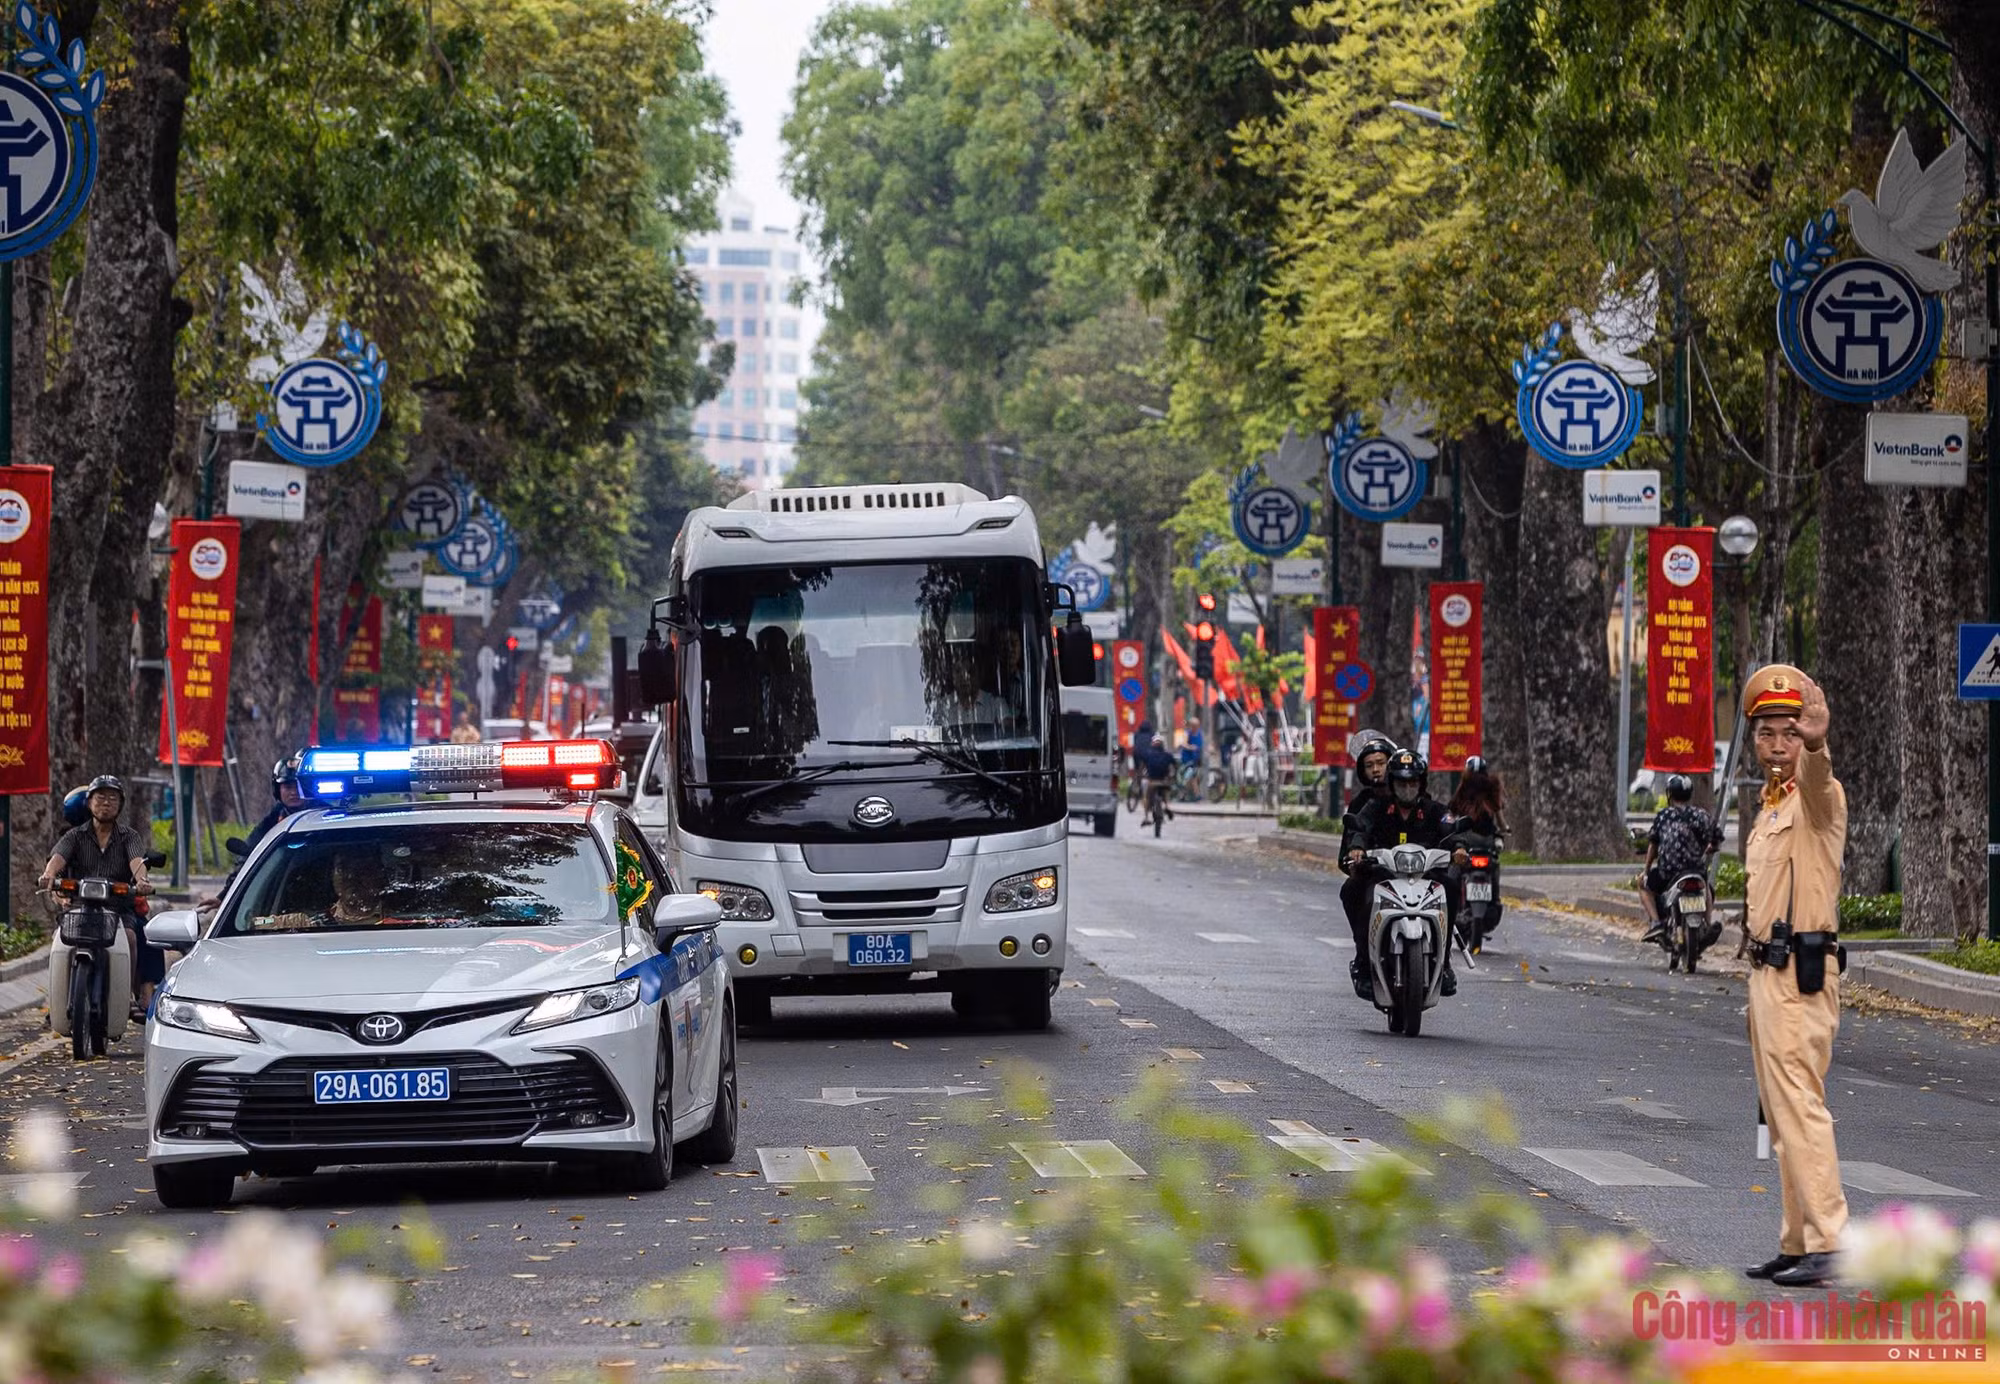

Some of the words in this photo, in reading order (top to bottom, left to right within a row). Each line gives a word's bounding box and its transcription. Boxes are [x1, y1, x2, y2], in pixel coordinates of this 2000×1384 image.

[1847, 368, 1860, 380] HÀ
[1862, 368, 1878, 381] NỘI
[1874, 441, 1945, 458] VietinBank
[233, 484, 286, 499] VietinBank
[1589, 493, 1643, 504] VietinBank
[22, 581, 39, 595] 1975
[866, 934, 894, 949] 80A
[856, 949, 905, 964] 060.32
[319, 1071, 446, 1100] 29A-061.85
